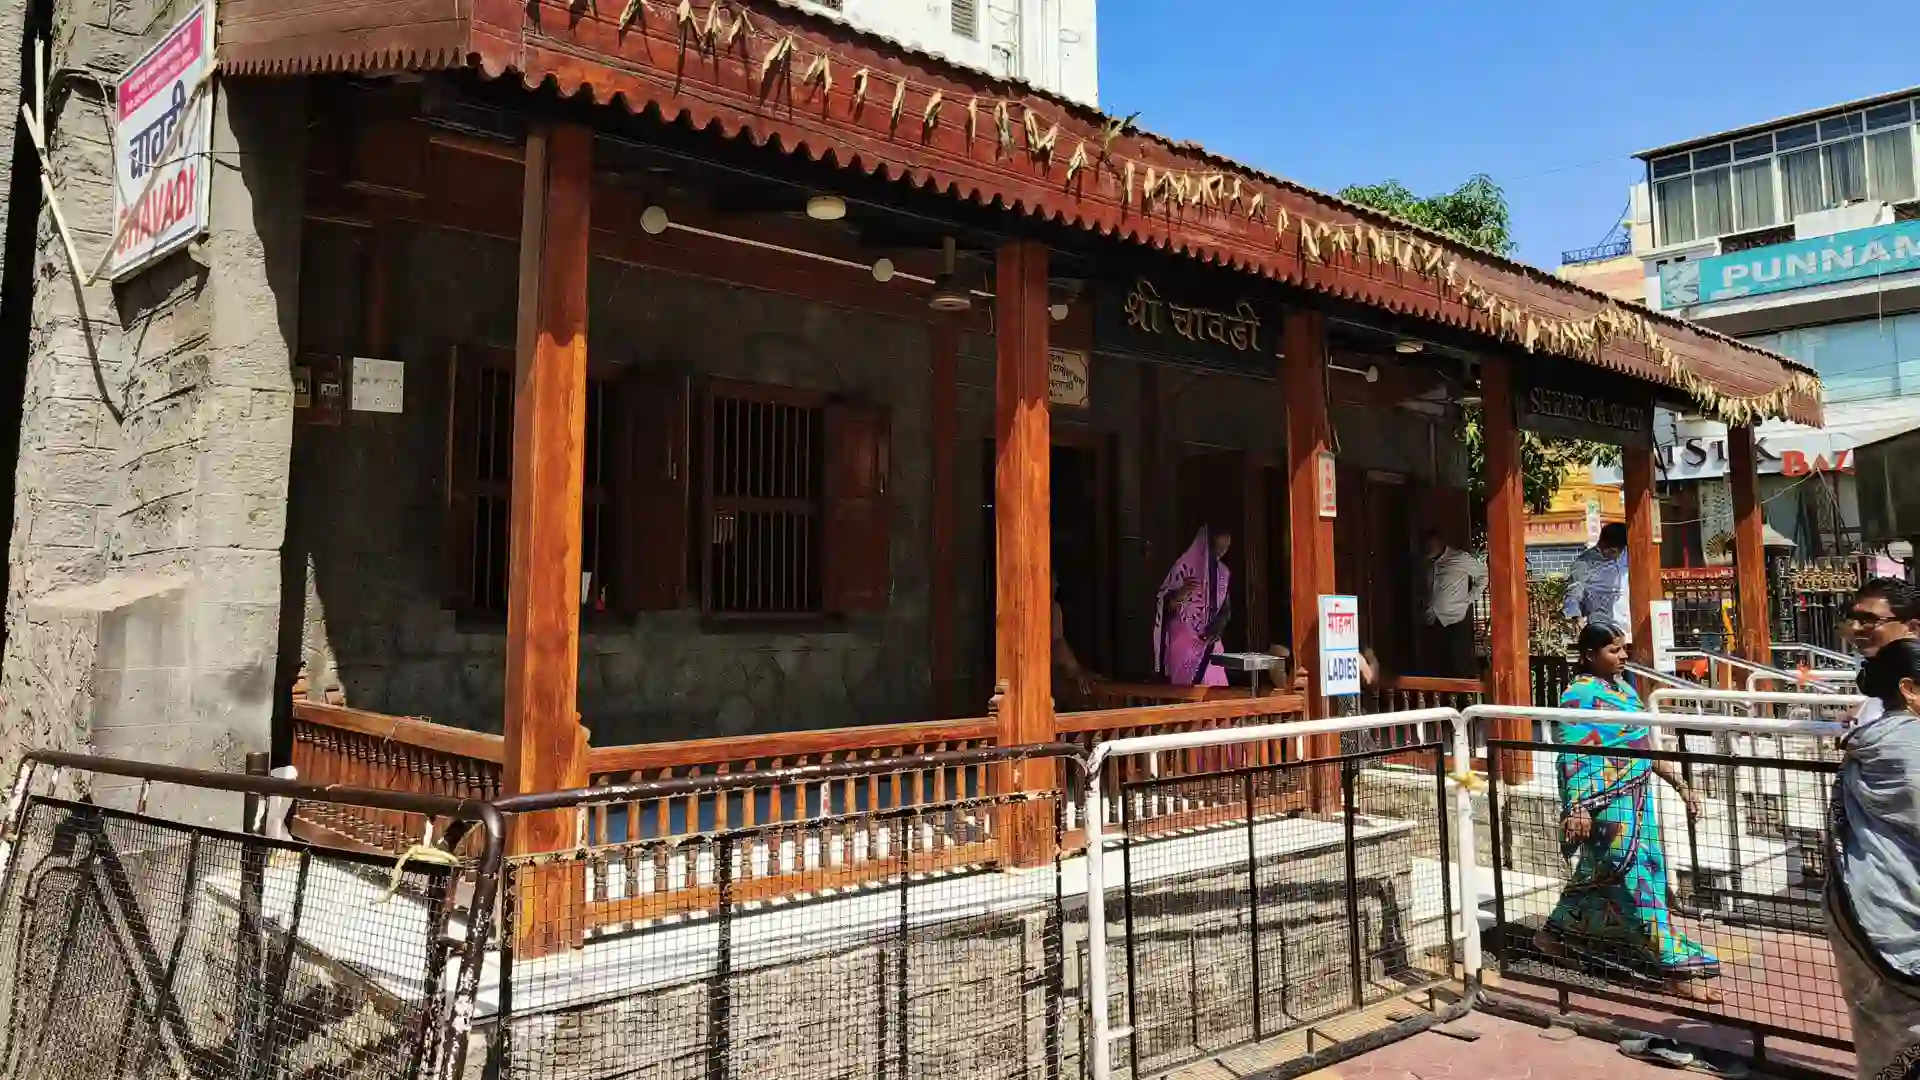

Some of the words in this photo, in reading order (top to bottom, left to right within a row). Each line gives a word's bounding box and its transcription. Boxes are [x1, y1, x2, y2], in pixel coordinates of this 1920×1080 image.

[1124, 280, 1162, 333] श्री
[1169, 301, 1261, 351] चावडी
[1327, 602, 1355, 635] महिला
[1327, 657, 1357, 681] LADIES
